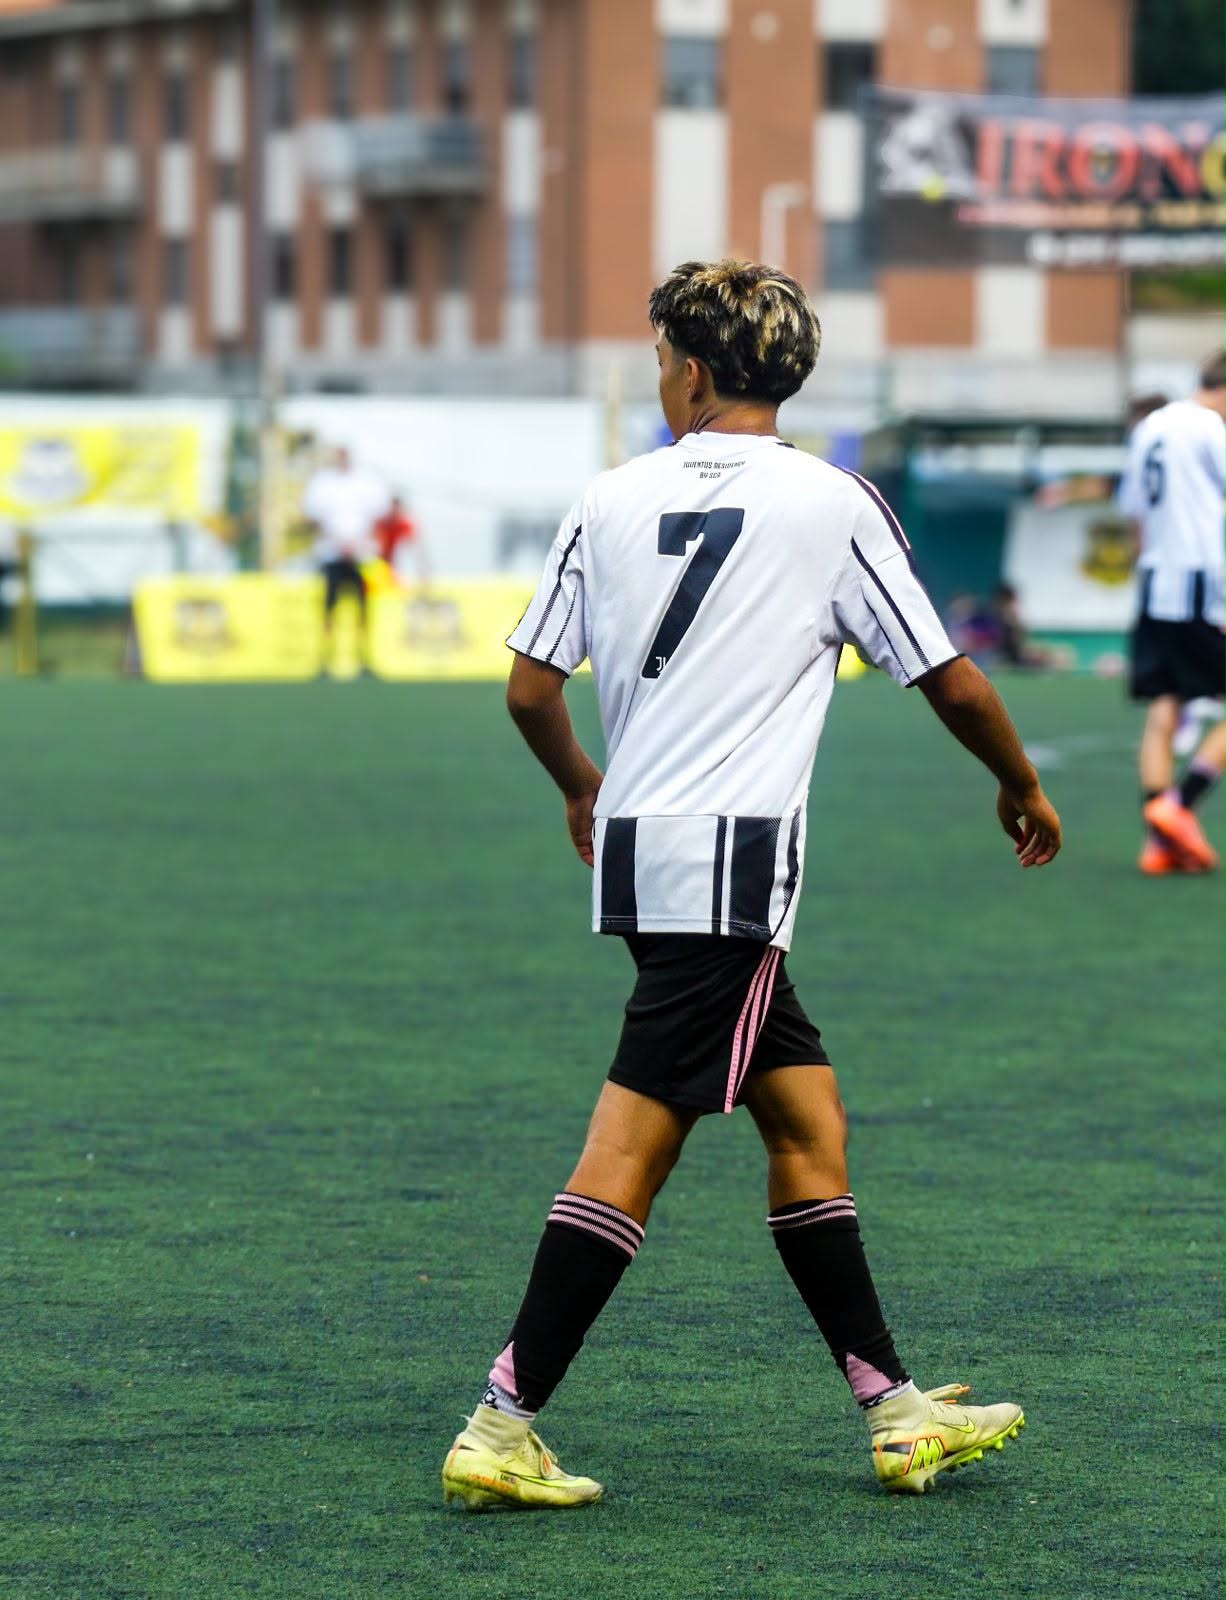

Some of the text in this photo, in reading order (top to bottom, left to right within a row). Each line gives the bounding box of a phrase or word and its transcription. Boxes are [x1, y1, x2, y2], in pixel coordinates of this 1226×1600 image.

[683, 461, 713, 469] JUVENTUS
[1143, 439, 1166, 507] 6
[642, 507, 745, 679] 7
